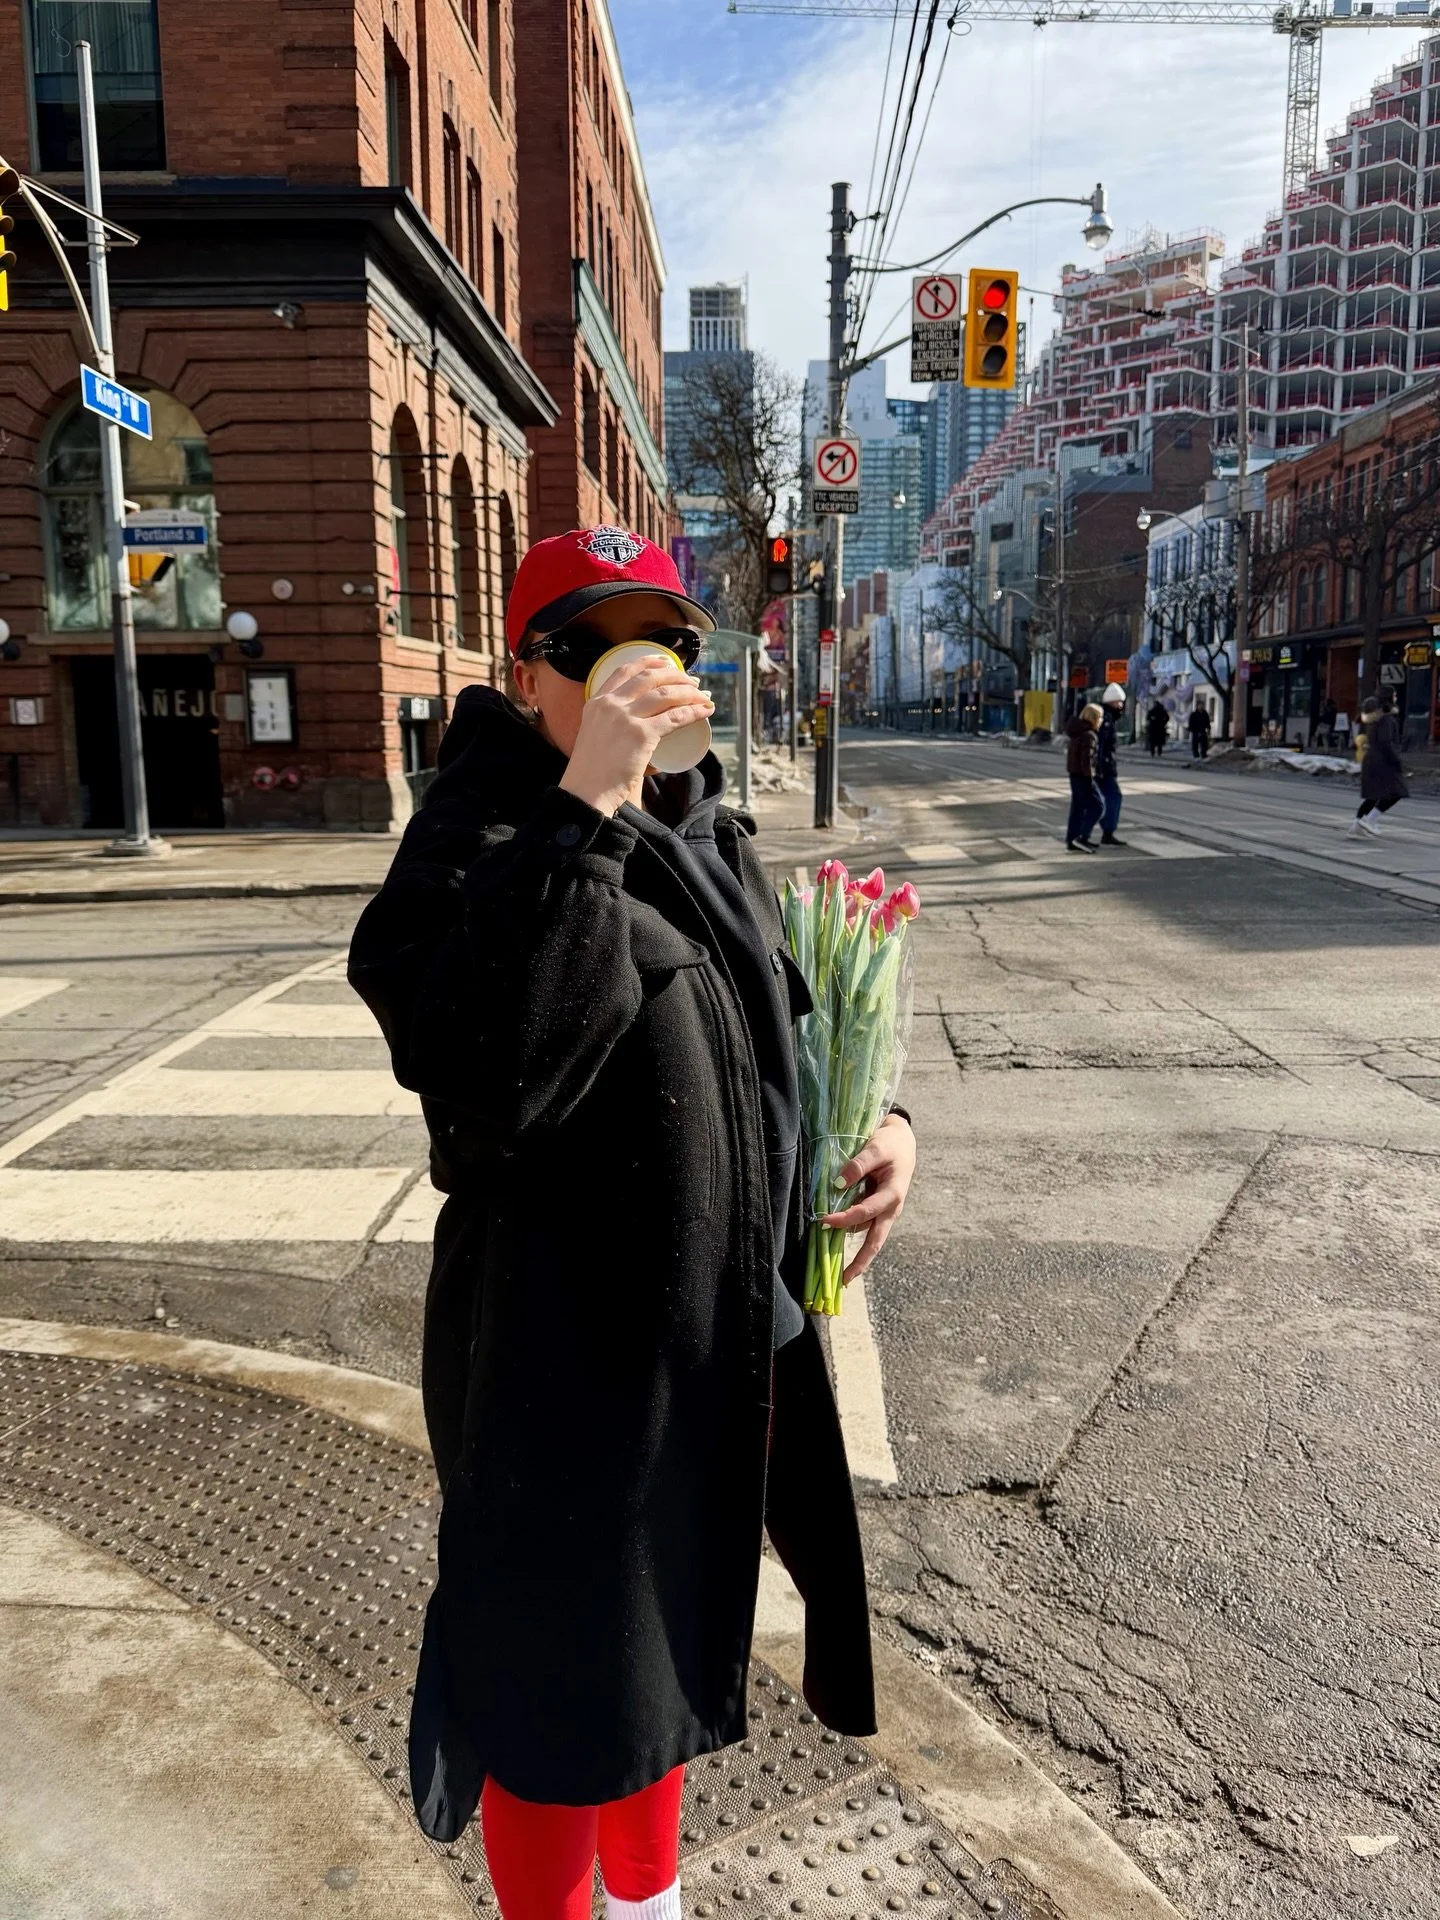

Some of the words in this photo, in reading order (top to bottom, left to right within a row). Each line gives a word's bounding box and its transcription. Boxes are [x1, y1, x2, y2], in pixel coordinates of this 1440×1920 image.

[918, 330, 954, 341] VEHICLES
[94, 377, 122, 420] King
[129, 397, 140, 423] W
[815, 501, 857, 512] EXCEPTED
[133, 528, 184, 542] Portland
[594, 537, 634, 548] TORONTO
